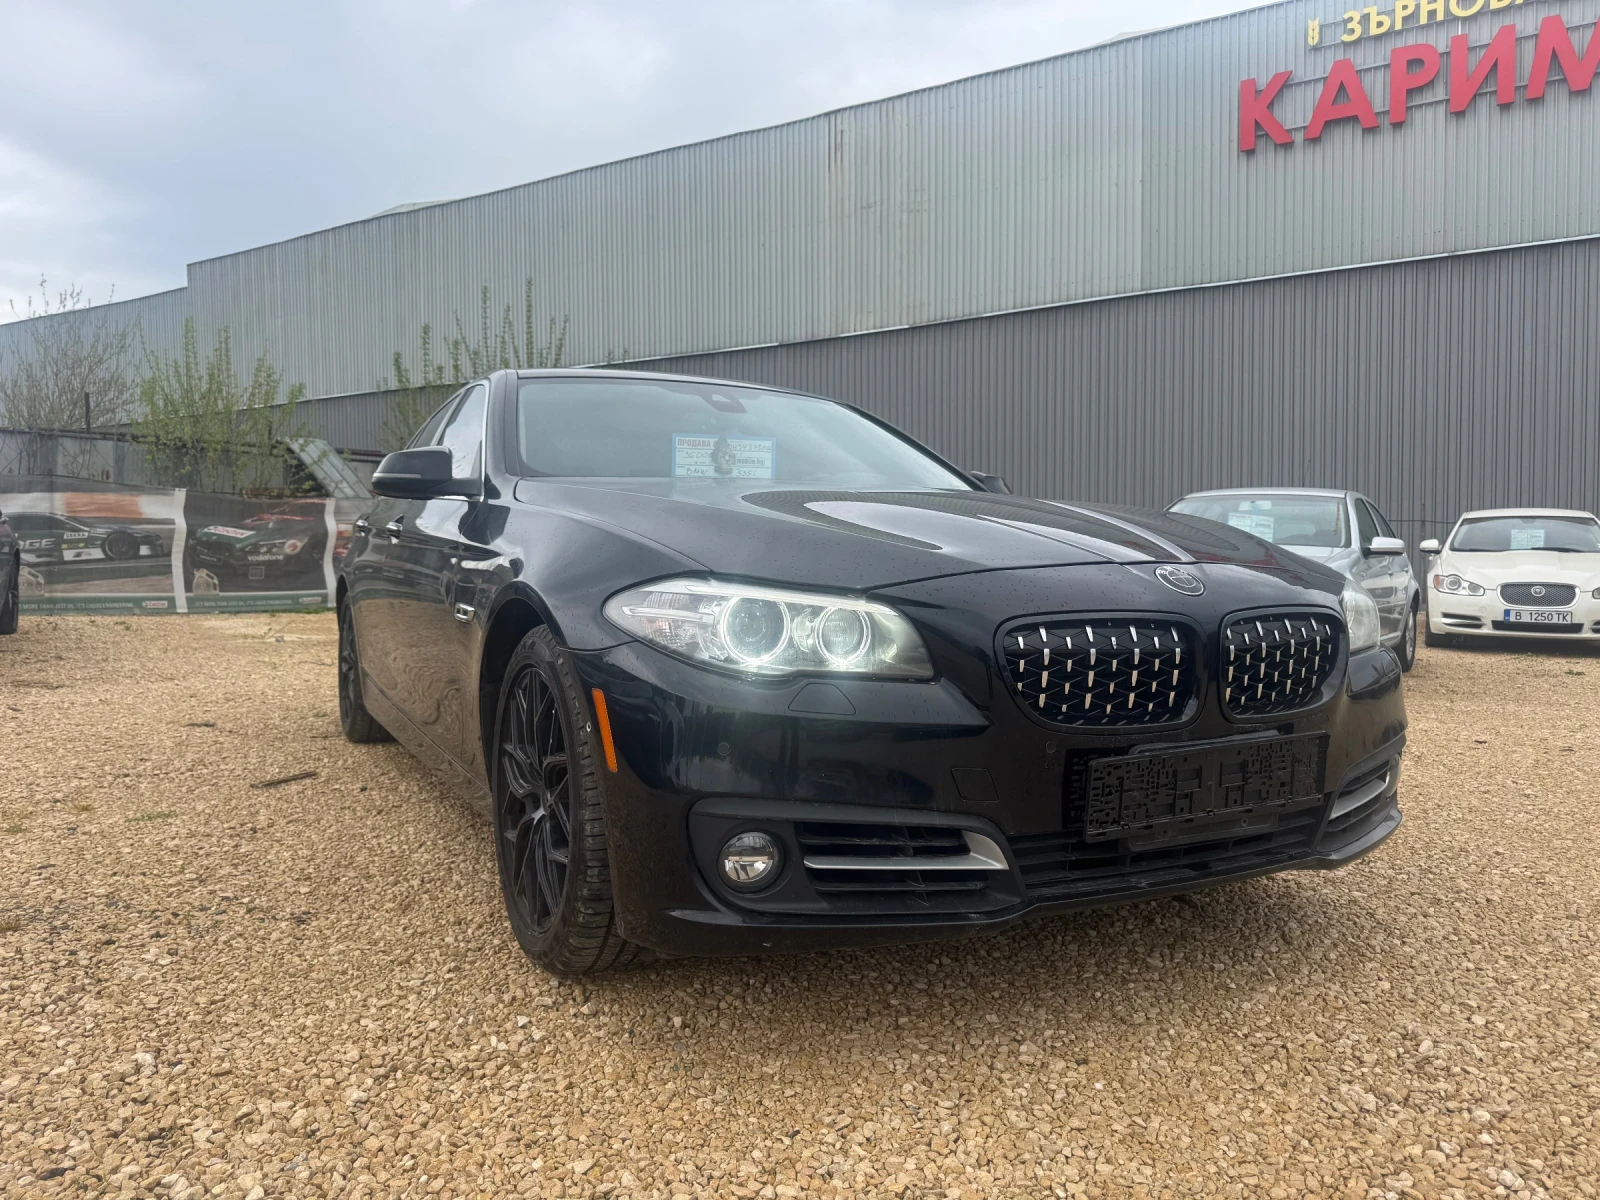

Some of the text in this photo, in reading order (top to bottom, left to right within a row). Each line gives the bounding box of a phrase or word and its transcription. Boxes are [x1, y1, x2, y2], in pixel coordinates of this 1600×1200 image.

[1340, 0, 1530, 42] ЗЪРНО
[1239, 14, 1600, 153] КАРИМ
[677, 438, 711, 448] ПРОДАВА
[686, 467, 708, 476] BMW
[247, 553, 284, 561] vodafone
[1515, 612, 1569, 623] B 1250 TK
